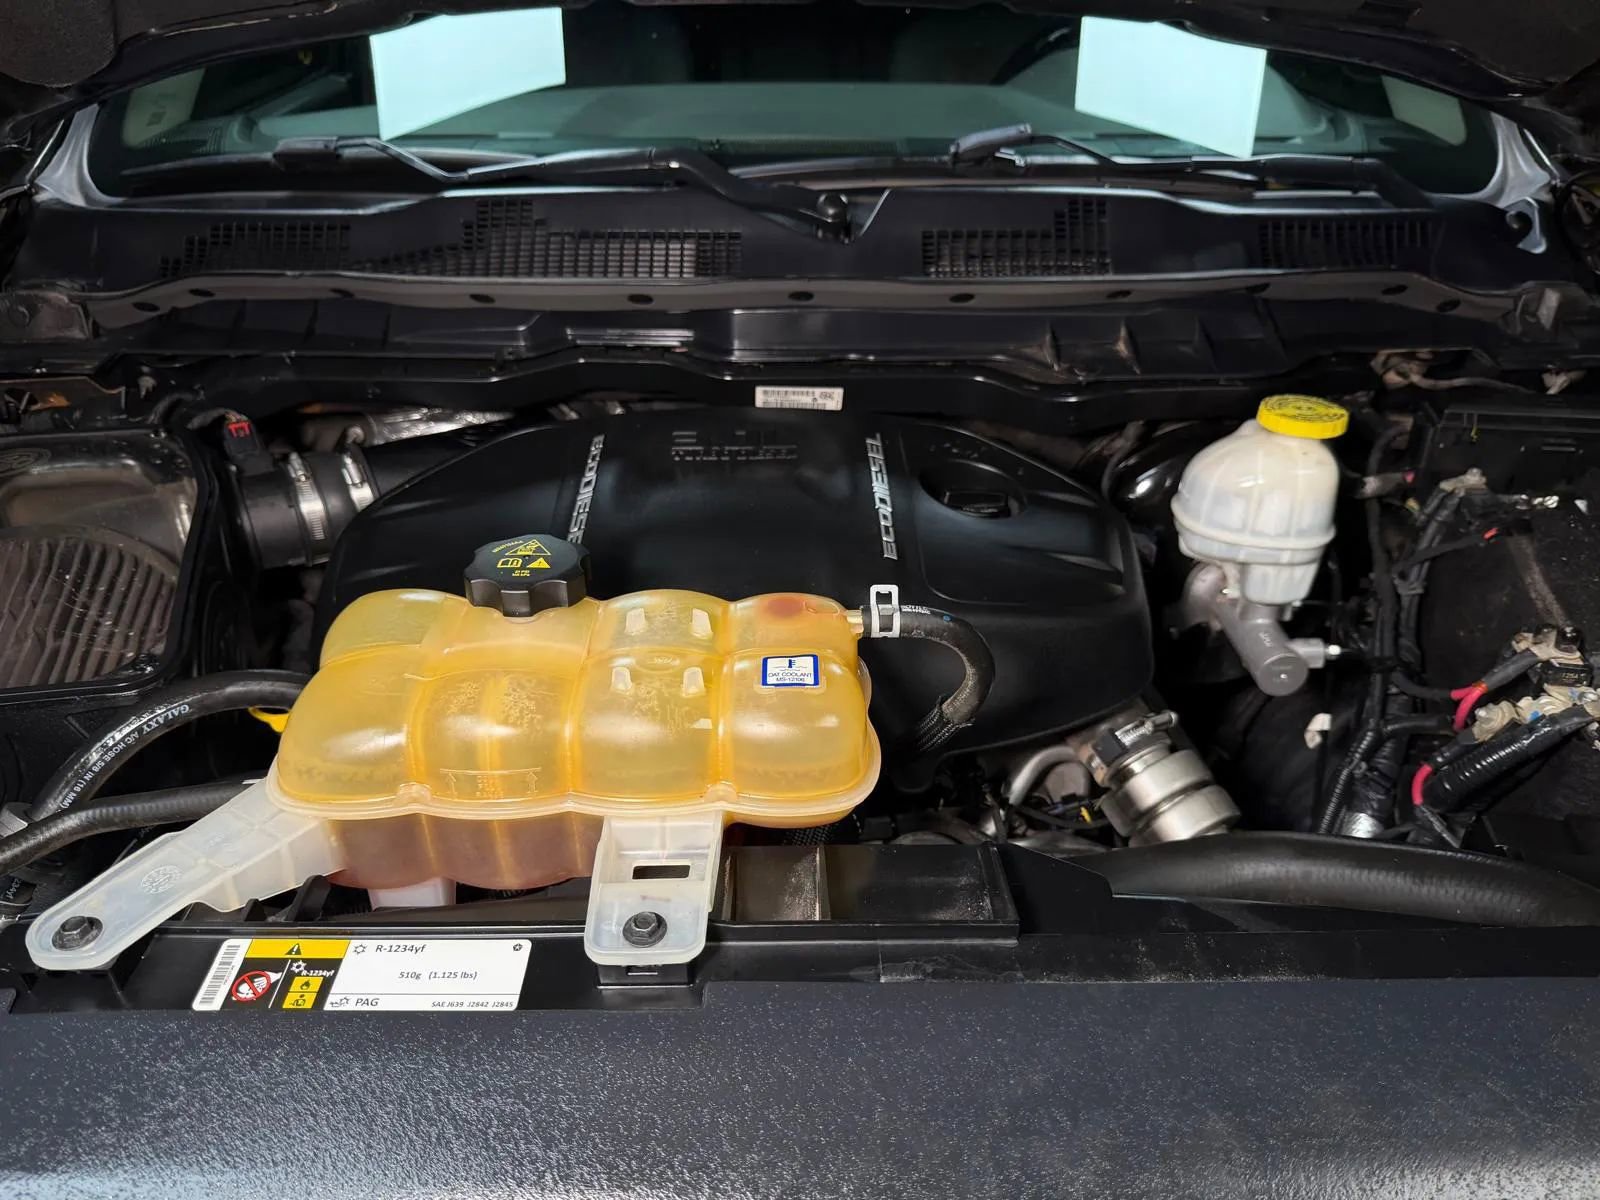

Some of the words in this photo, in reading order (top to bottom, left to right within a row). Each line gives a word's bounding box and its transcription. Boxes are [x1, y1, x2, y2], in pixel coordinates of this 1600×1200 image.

[567, 434, 605, 544] ECODIESE
[865, 432, 898, 560] ECODIESEL
[141, 703, 190, 735] GALAXY
[124, 731, 140, 744] A/C
[102, 741, 126, 762] HOSE
[92, 760, 105, 773] 5/8
[83, 771, 94, 781] IN
[73, 779, 87, 794] (16
[60, 791, 77, 809] MM)
[375, 944, 427, 954] R-1234yf
[301, 969, 335, 977] R-1234yf
[398, 971, 422, 980] 510g
[428, 971, 458, 980] (1.125
[460, 971, 478, 980] lbs)
[355, 997, 380, 1007] PAG
